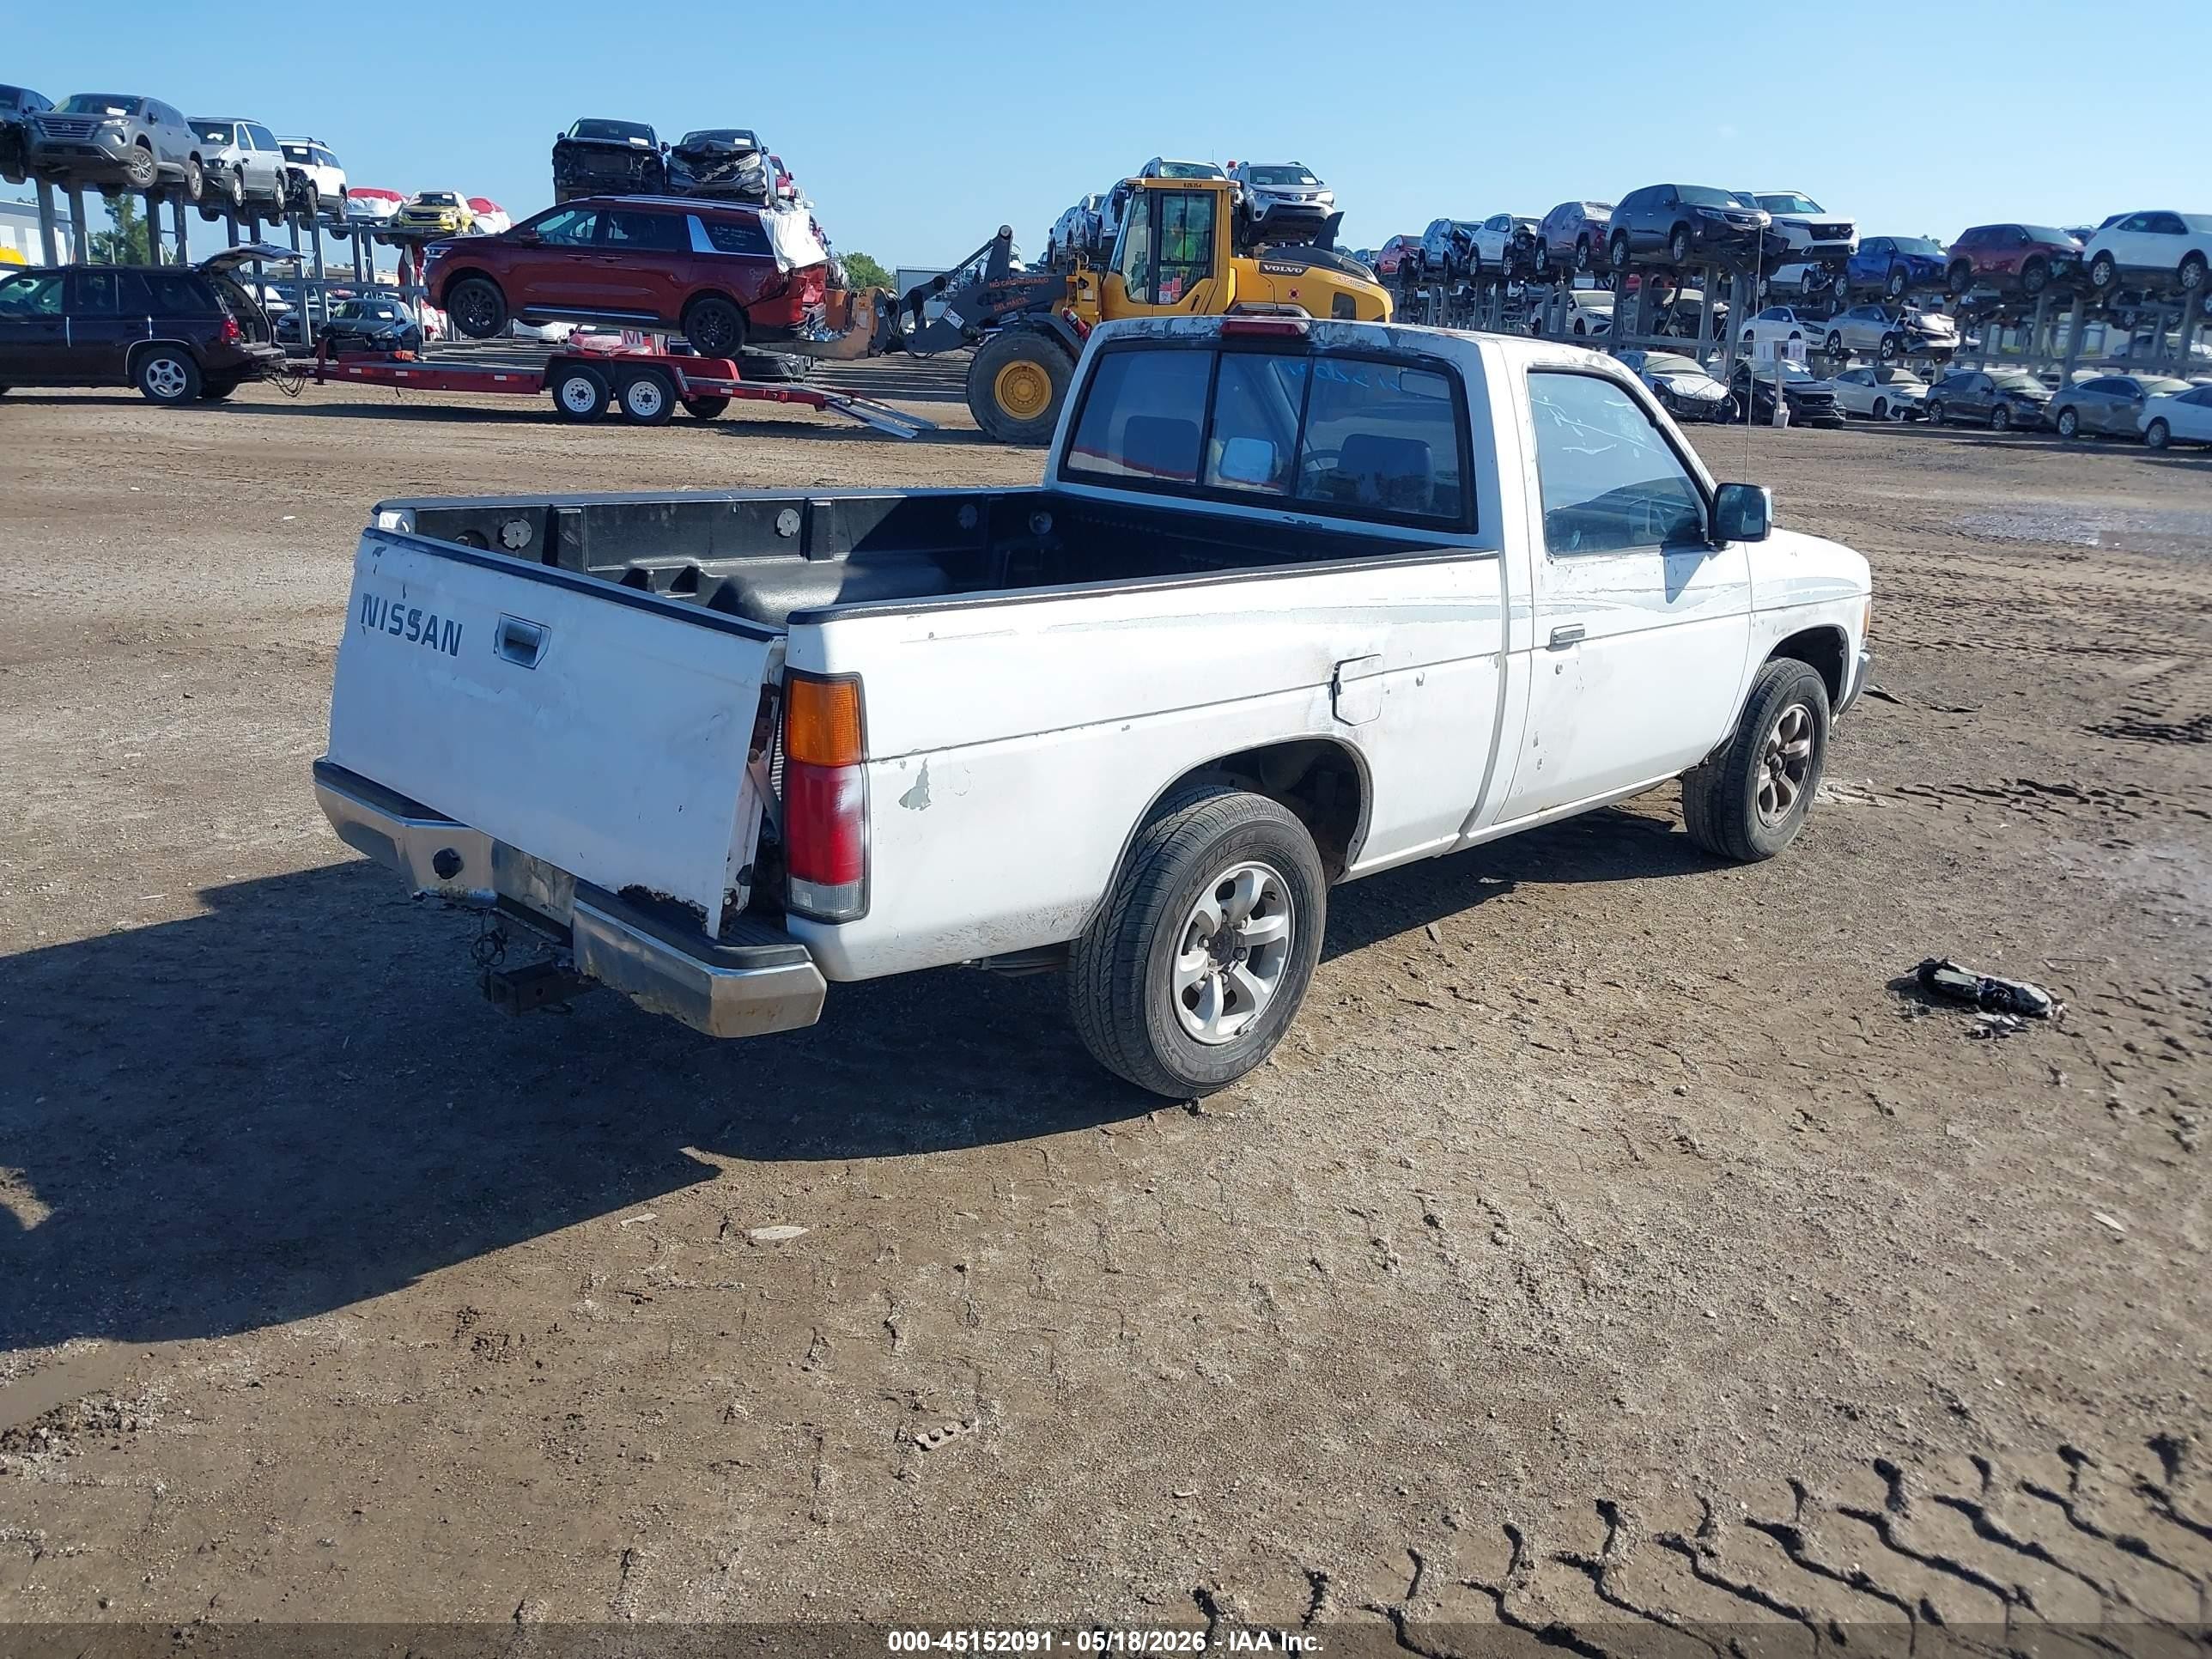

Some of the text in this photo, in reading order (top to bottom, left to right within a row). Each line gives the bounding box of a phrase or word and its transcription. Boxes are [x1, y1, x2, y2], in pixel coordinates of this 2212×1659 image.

[1263, 264, 1303, 274] VOLVO
[623, 330, 641, 344] M
[1792, 344, 1802, 358] H
[361, 592, 463, 657] NISSAN
